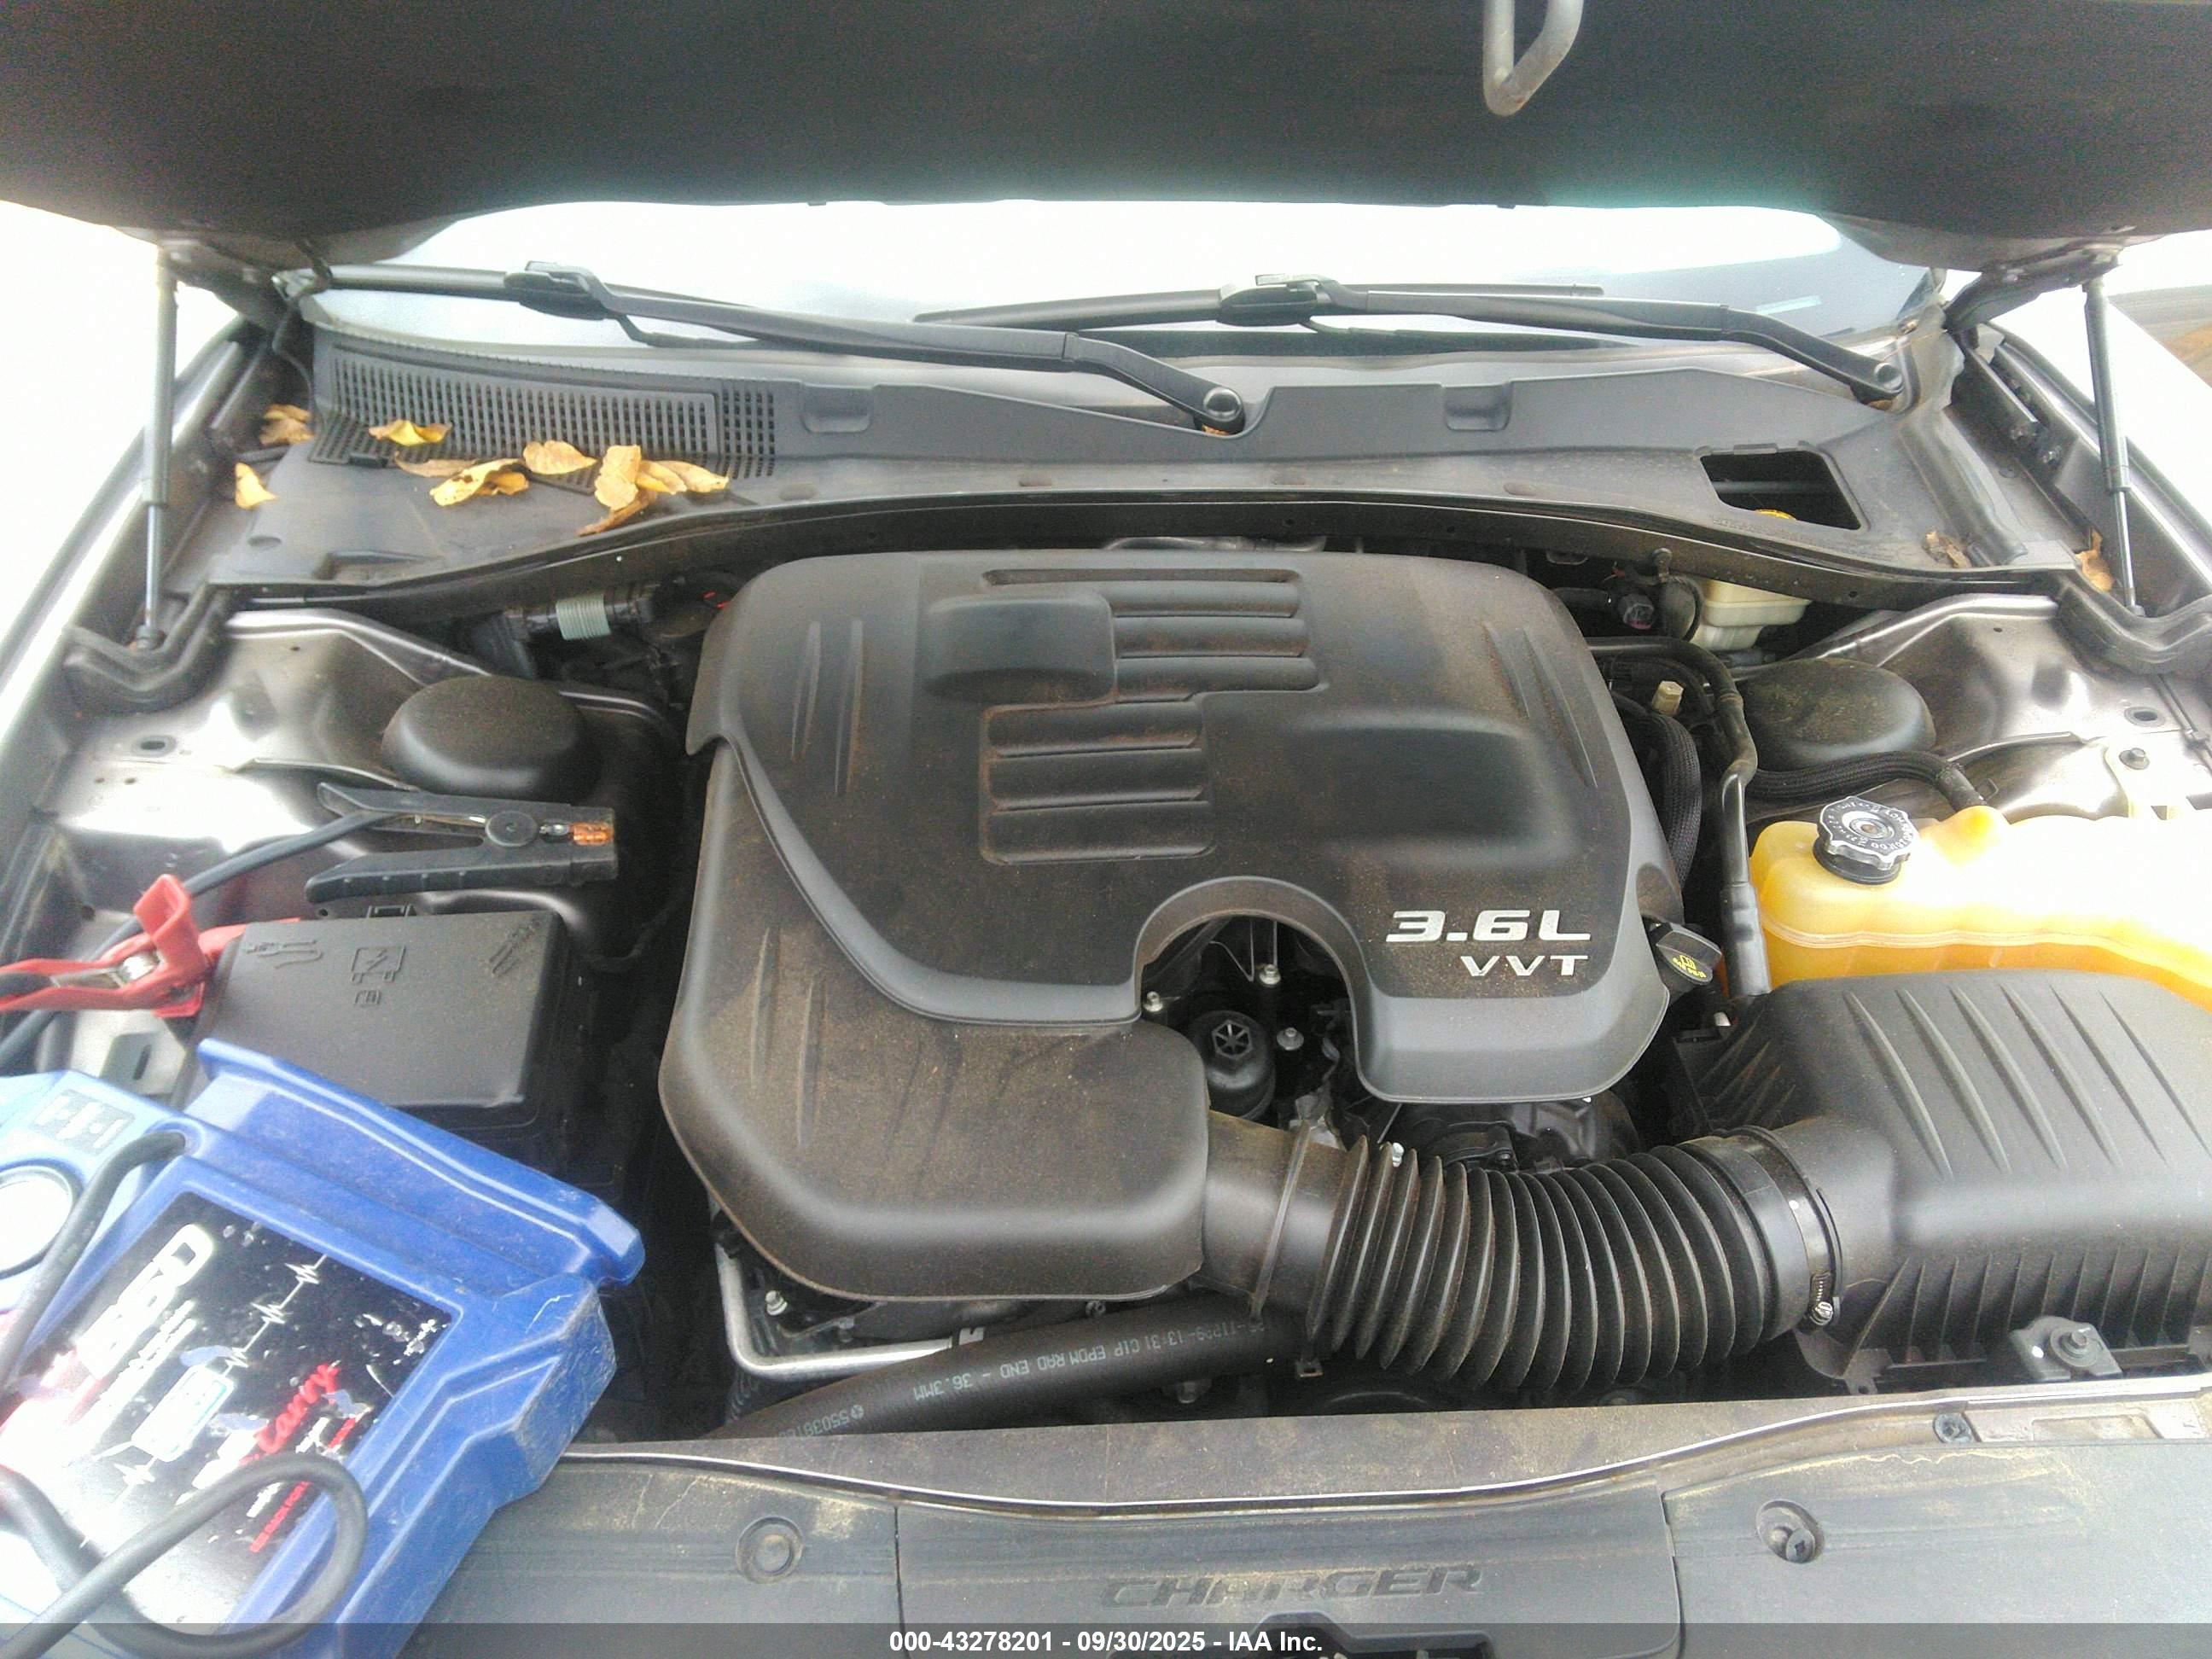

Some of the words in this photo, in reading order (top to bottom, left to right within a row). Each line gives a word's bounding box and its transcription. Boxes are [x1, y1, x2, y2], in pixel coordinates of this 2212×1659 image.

[1386, 910, 1591, 942] 3.6L
[1460, 955, 1588, 977] VVT
[1037, 1352, 1066, 1371] RAD
[1069, 1345, 1107, 1366] EPDM
[999, 1359, 1030, 1379] END
[913, 1372, 973, 1401] 36.3MM
[1101, 1569, 1483, 1610] CHARGER
